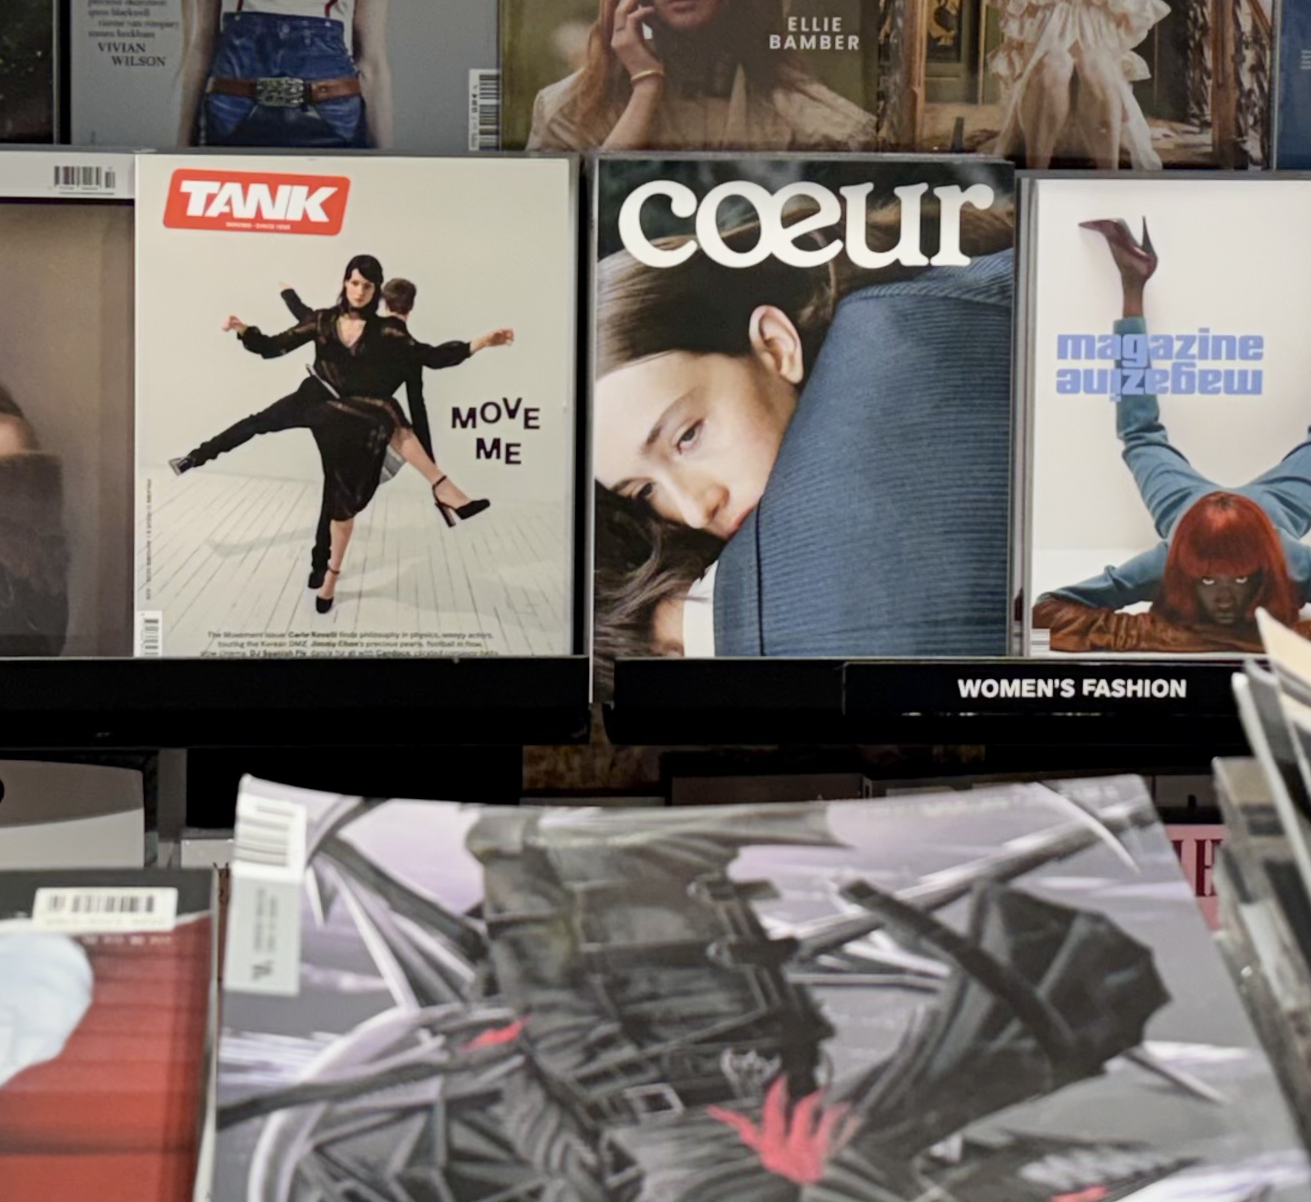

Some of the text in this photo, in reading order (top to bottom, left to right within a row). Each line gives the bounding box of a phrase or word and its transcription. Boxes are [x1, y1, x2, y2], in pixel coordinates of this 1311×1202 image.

[787, 16, 843, 34] ELLIE
[98, 42, 147, 54] VIVIAN
[768, 34, 861, 51] BAMBER
[111, 55, 167, 67] WILSON
[179, 179, 339, 223] TANK
[617, 178, 995, 269] cœur
[1056, 327, 1265, 370] magazine
[451, 397, 541, 430] MOVE
[475, 437, 522, 465] ME
[957, 677, 1187, 698] WOMEN'S FASHION
